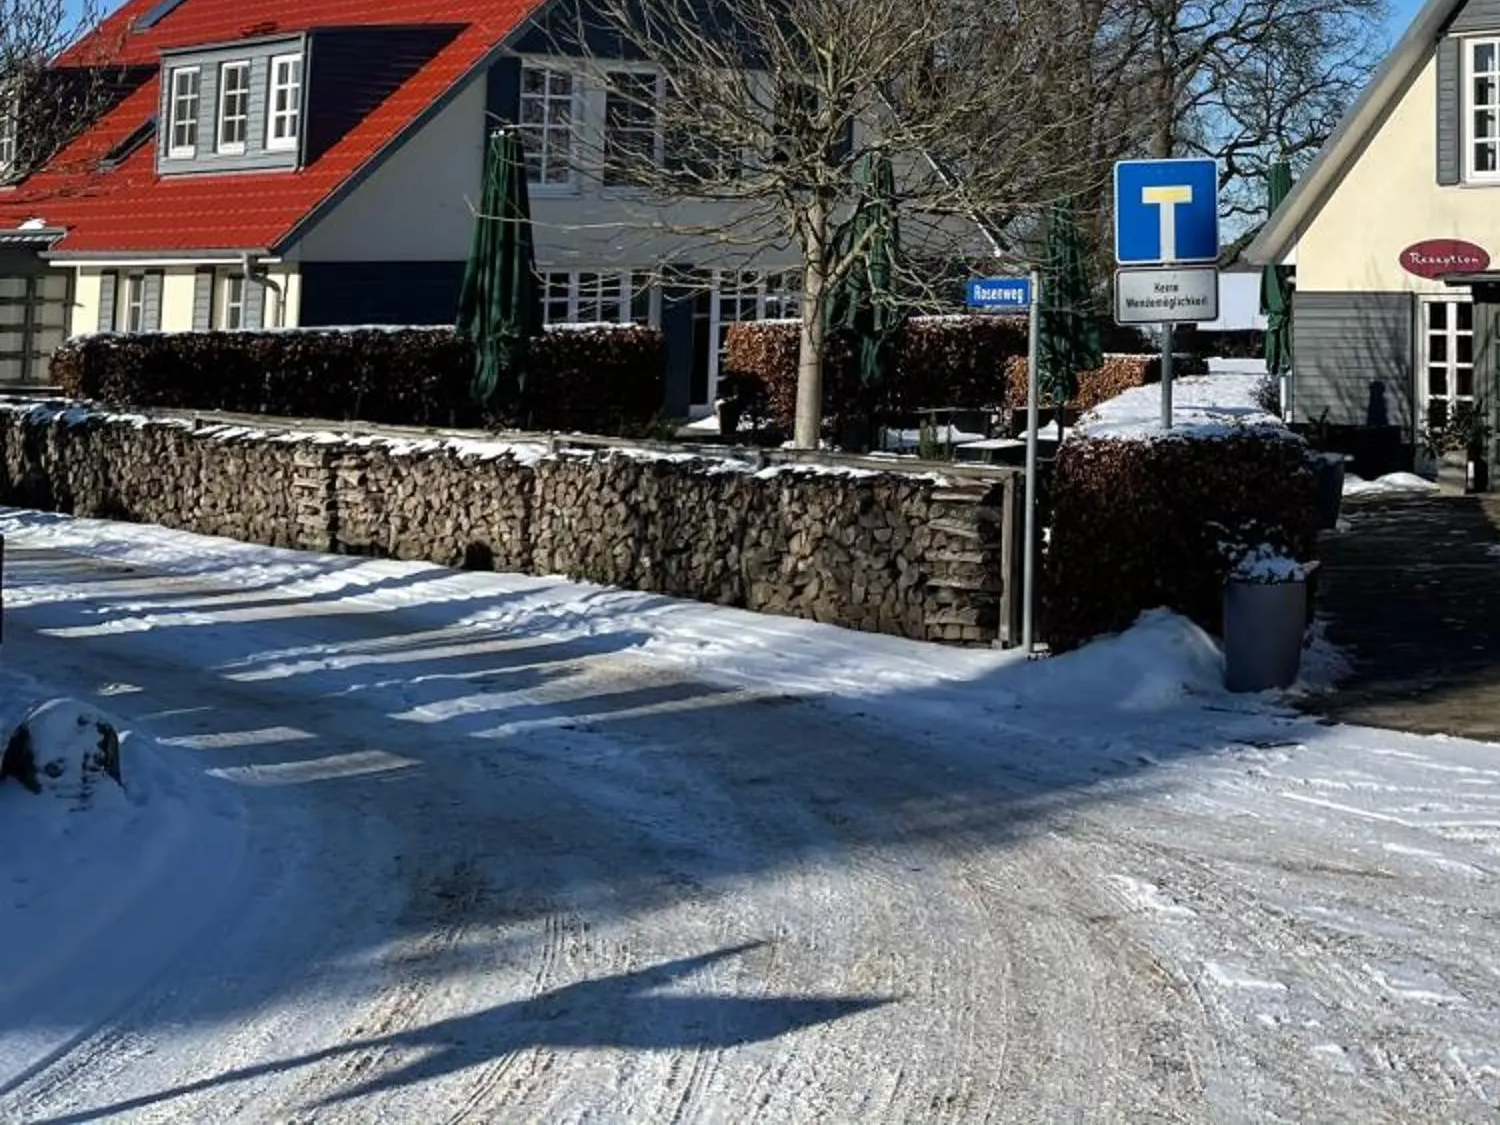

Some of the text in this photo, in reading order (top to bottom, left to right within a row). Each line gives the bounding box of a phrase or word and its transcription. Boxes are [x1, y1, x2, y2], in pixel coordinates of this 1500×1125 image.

[973, 284, 1024, 304] Rosenweg
[1153, 282, 1179, 293] Keine
[1125, 295, 1208, 309] Wendemöglichkeit
